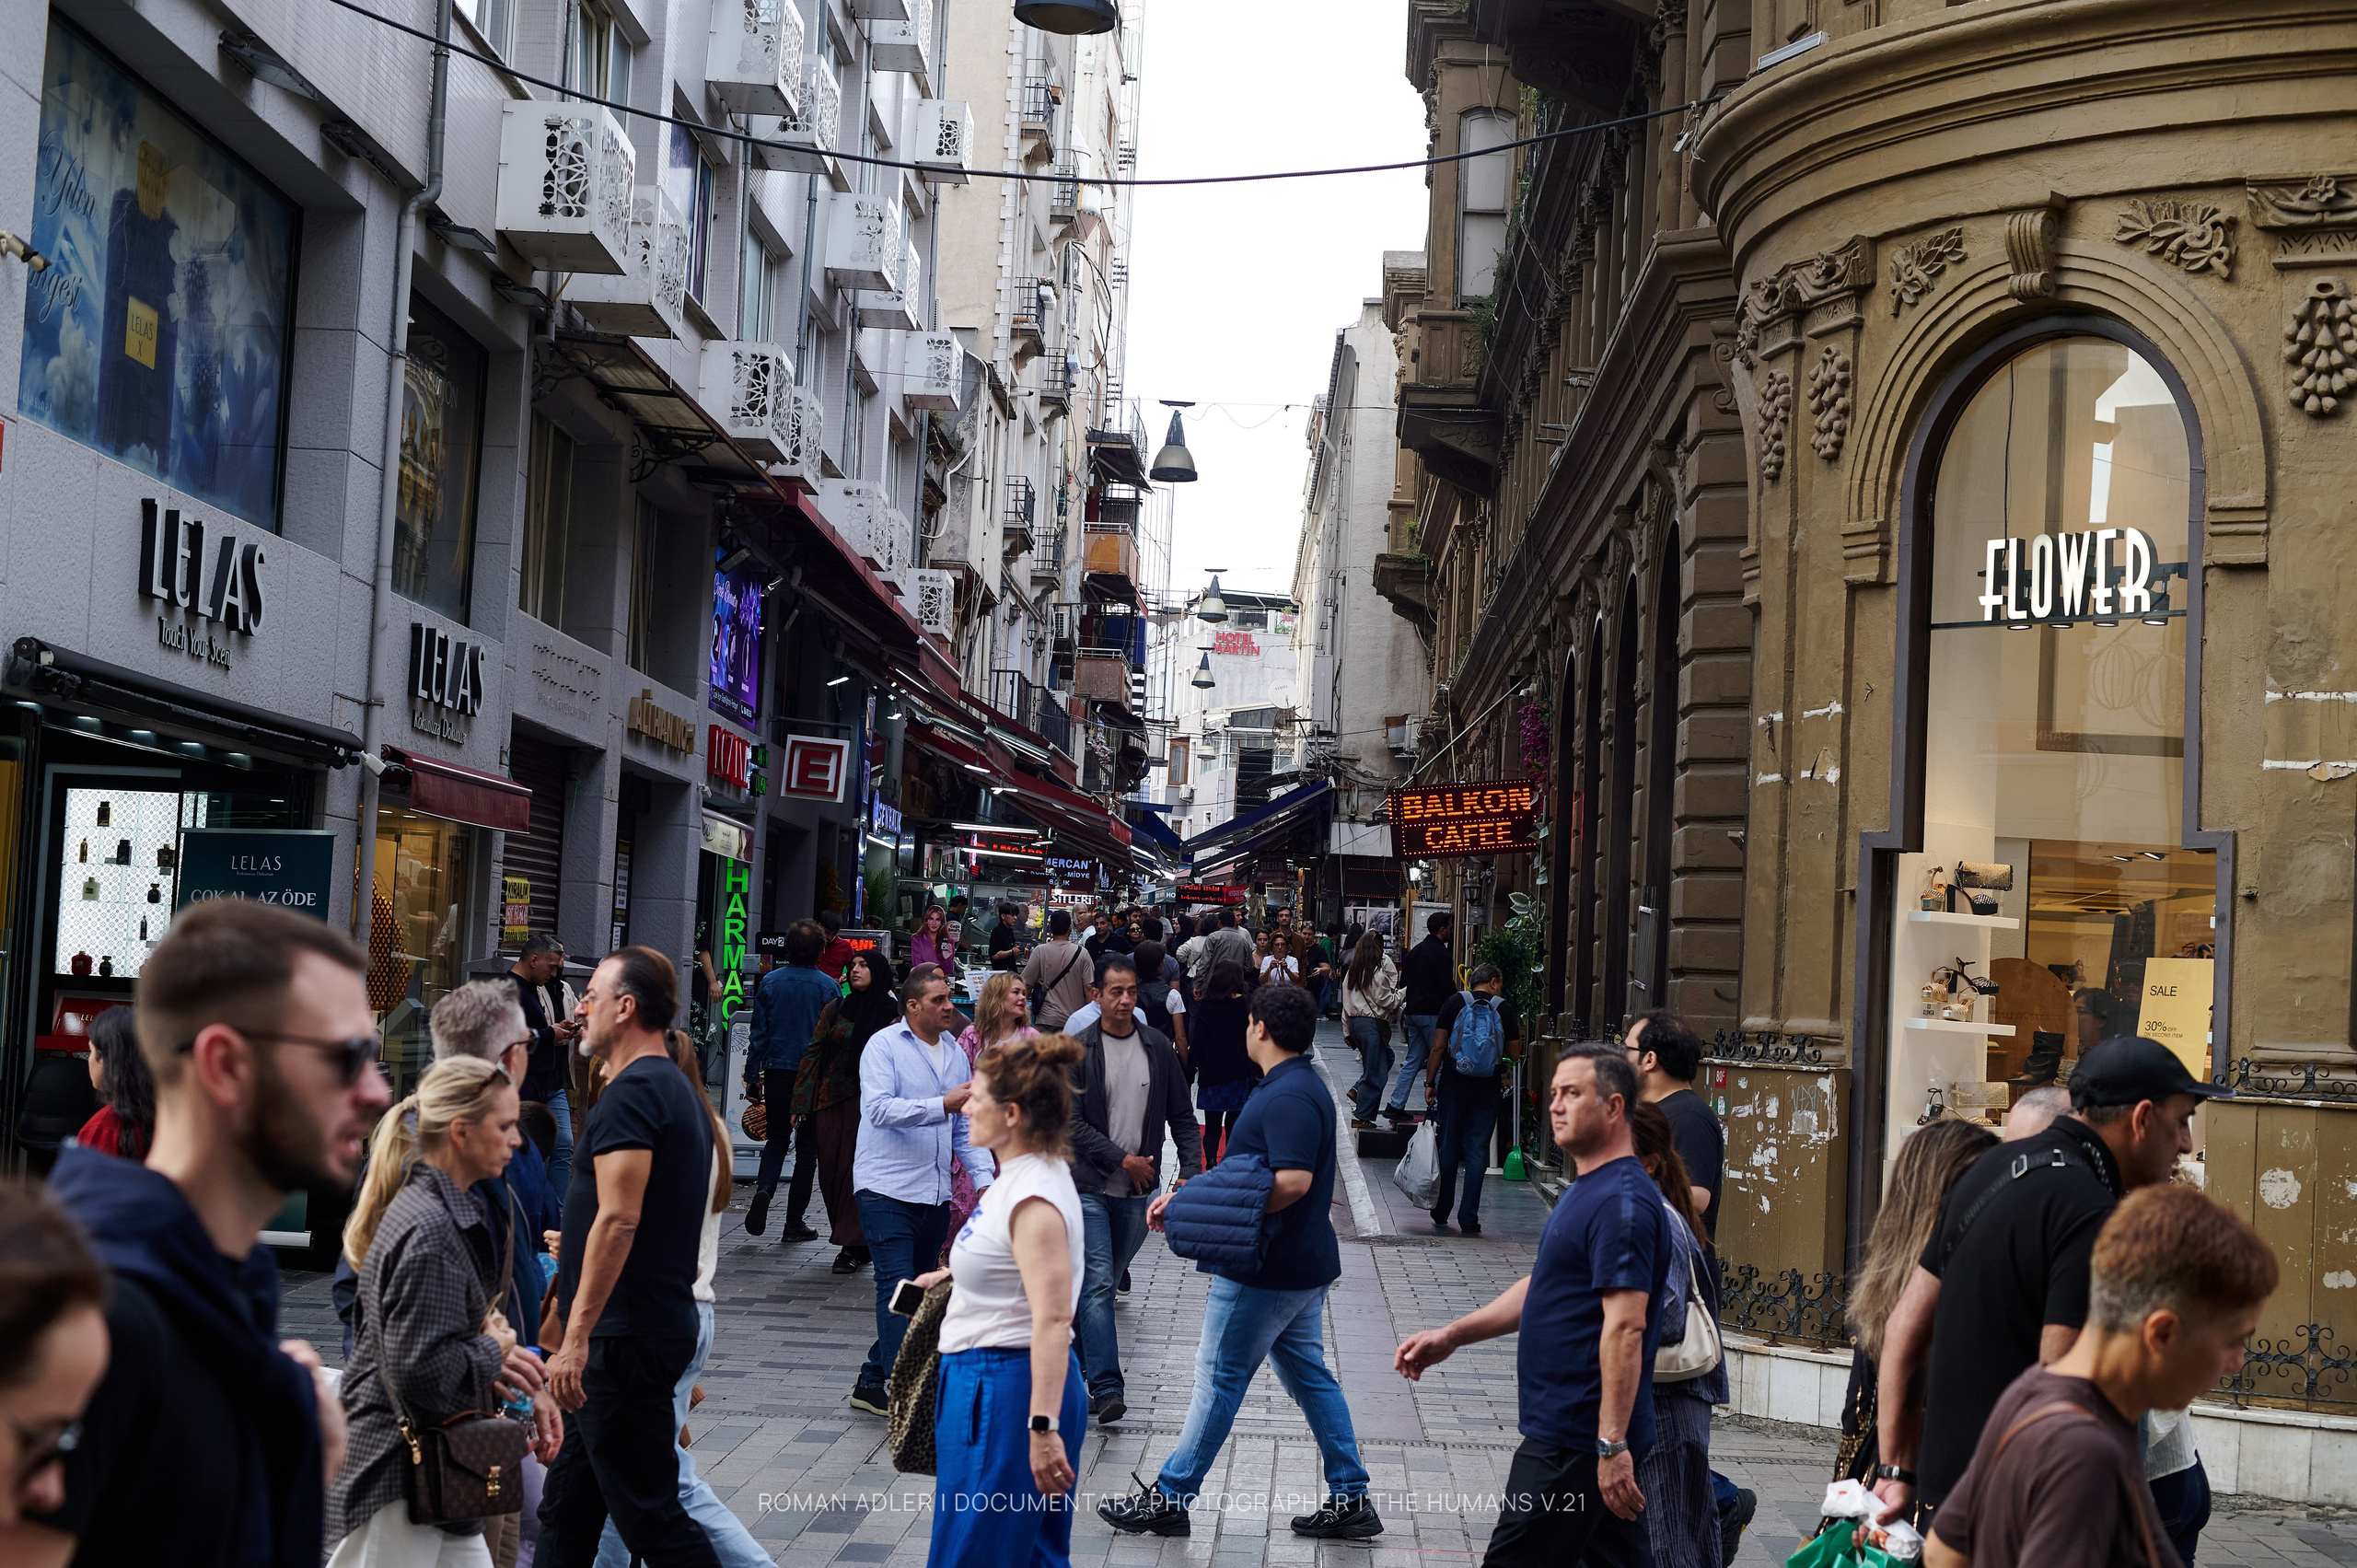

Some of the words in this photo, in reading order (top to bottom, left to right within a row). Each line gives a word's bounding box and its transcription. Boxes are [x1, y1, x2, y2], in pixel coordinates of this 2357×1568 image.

[131, 313, 154, 341] LELAS
[139, 498, 266, 636] LELAS
[1979, 527, 2155, 621] FLOWER
[159, 617, 187, 650] Touch
[1215, 631, 1254, 645] HOTEL
[1212, 643, 1260, 656] MARTIN
[408, 623, 485, 717] LELAS
[795, 747, 833, 791] E
[1402, 787, 1532, 819] BALKON
[1425, 821, 1513, 849] CAFEE
[231, 855, 282, 871] LELAS
[1260, 861, 1283, 870] DEHA
[257, 890, 278, 905] AZ
[282, 889, 317, 906] ÖDE
[2149, 984, 2178, 997] SALE
[2144, 1020, 2167, 1032] 30%
